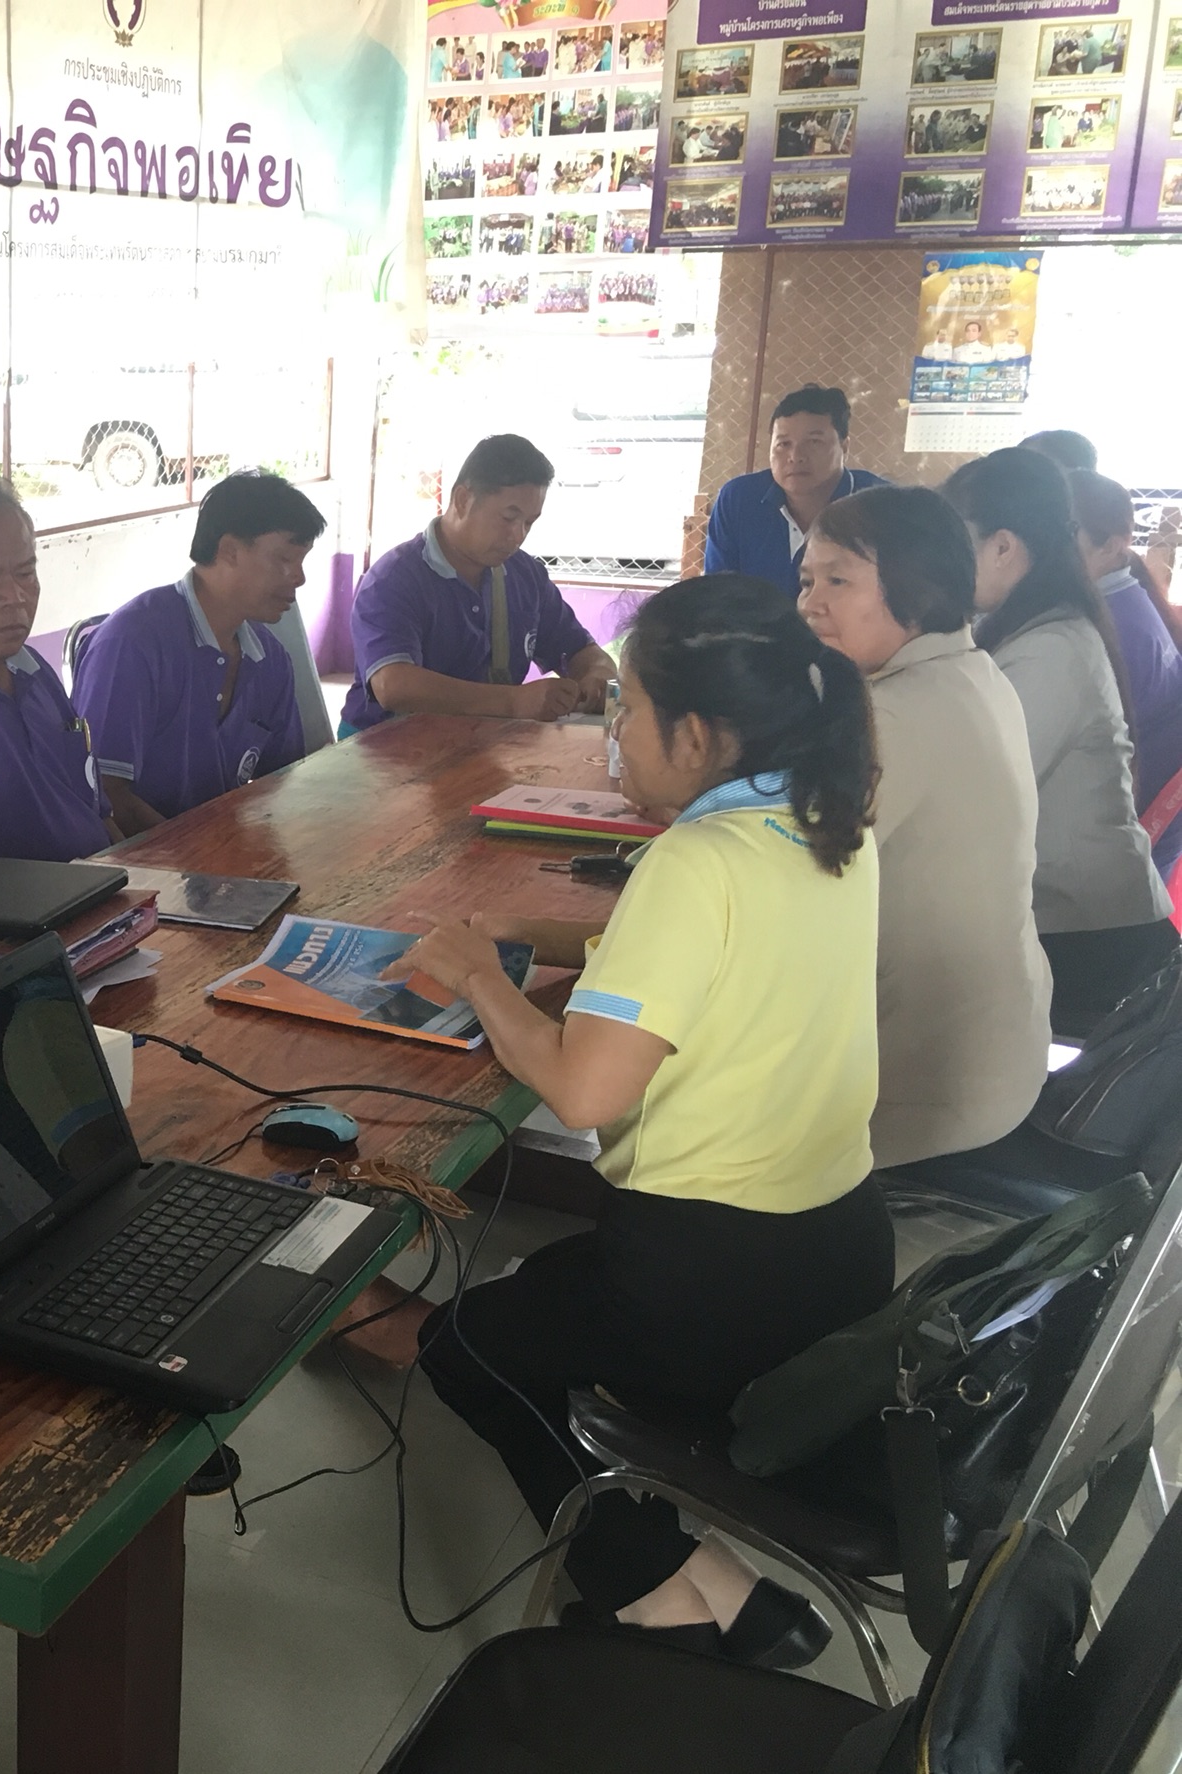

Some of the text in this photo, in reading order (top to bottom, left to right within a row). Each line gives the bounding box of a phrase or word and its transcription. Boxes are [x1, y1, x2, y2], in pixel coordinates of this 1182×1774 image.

[719, 10, 844, 37] หมู่บ้านโครงการเศรษฐกิจพอเพียง
[64, 57, 182, 98] การประชุมเชิงปฏิบัติการ
